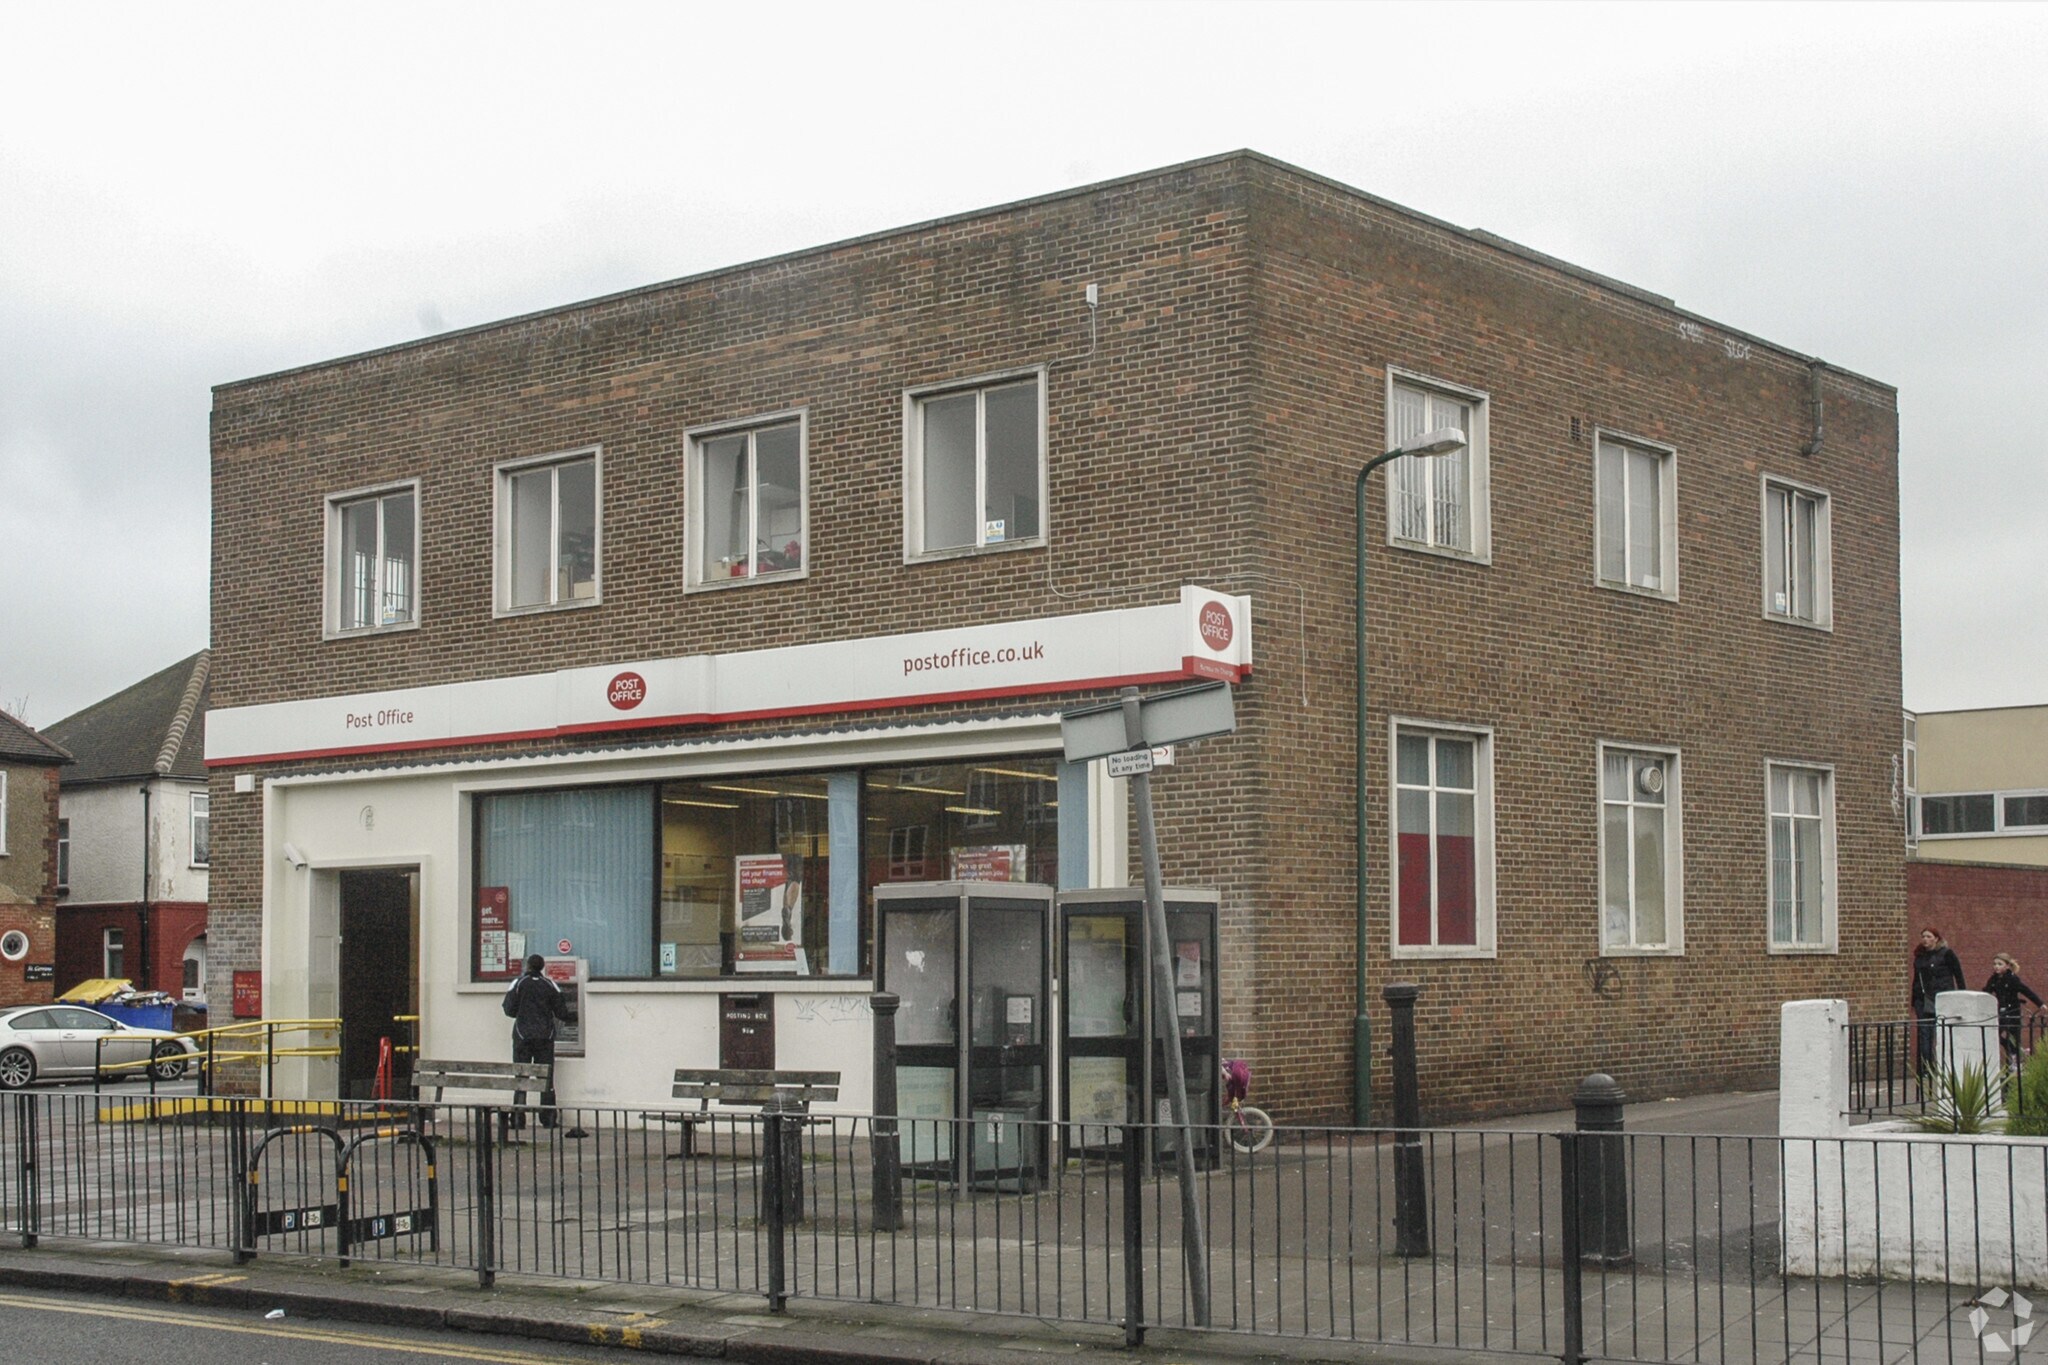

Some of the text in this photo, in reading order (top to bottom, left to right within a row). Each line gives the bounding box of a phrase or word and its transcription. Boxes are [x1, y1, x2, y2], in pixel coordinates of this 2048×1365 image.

[1206, 610, 1226, 626] POST
[1201, 623, 1229, 641] OFFICE
[903, 641, 1044, 676] postoffice.co.uk
[615, 678, 640, 690] POST
[610, 689, 642, 702] OFFICE
[346, 709, 414, 729] Post Office
[1123, 753, 1148, 763] loading
[1135, 762, 1151, 770] time
[970, 863, 977, 871] up
[978, 862, 992, 871] great
[762, 869, 783, 877] finances
[481, 907, 493, 916] get
